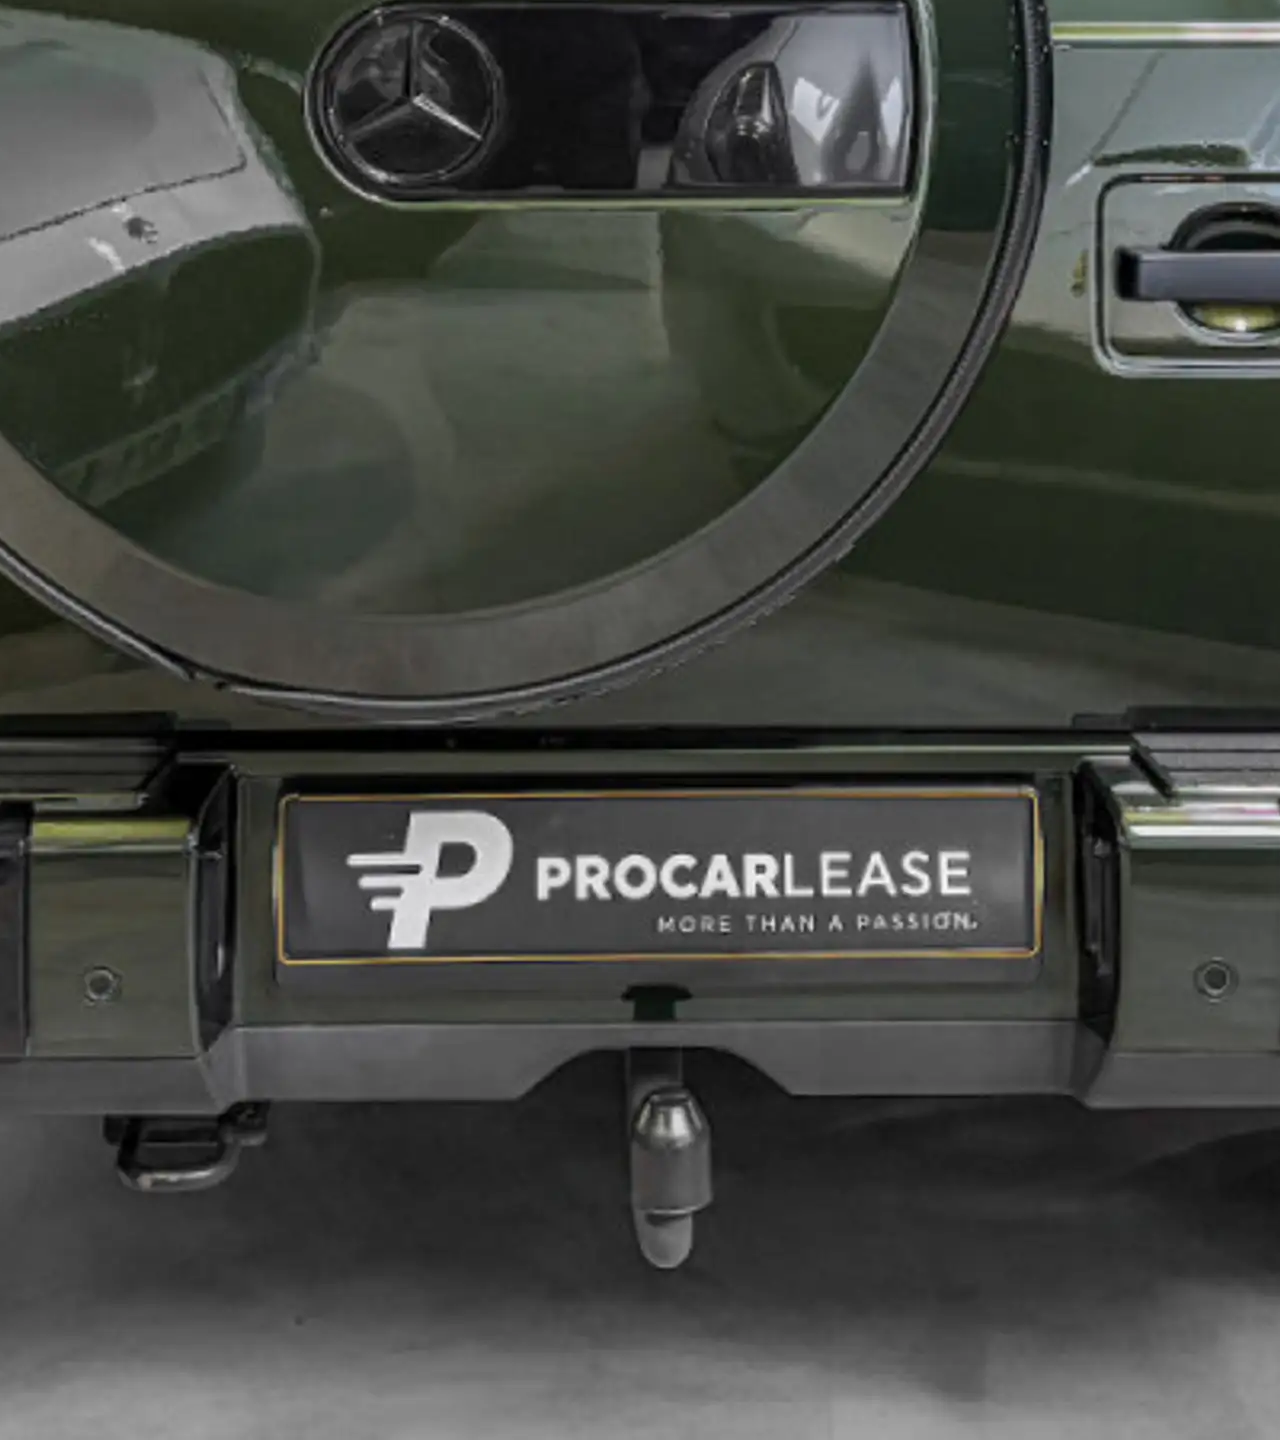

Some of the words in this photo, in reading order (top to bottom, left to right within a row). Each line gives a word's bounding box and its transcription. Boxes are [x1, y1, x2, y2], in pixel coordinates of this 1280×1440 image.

[536, 850, 973, 901] PROCARLEASE
[657, 914, 732, 934] MORE
[744, 913, 816, 933] THAN
[827, 913, 844, 932] A
